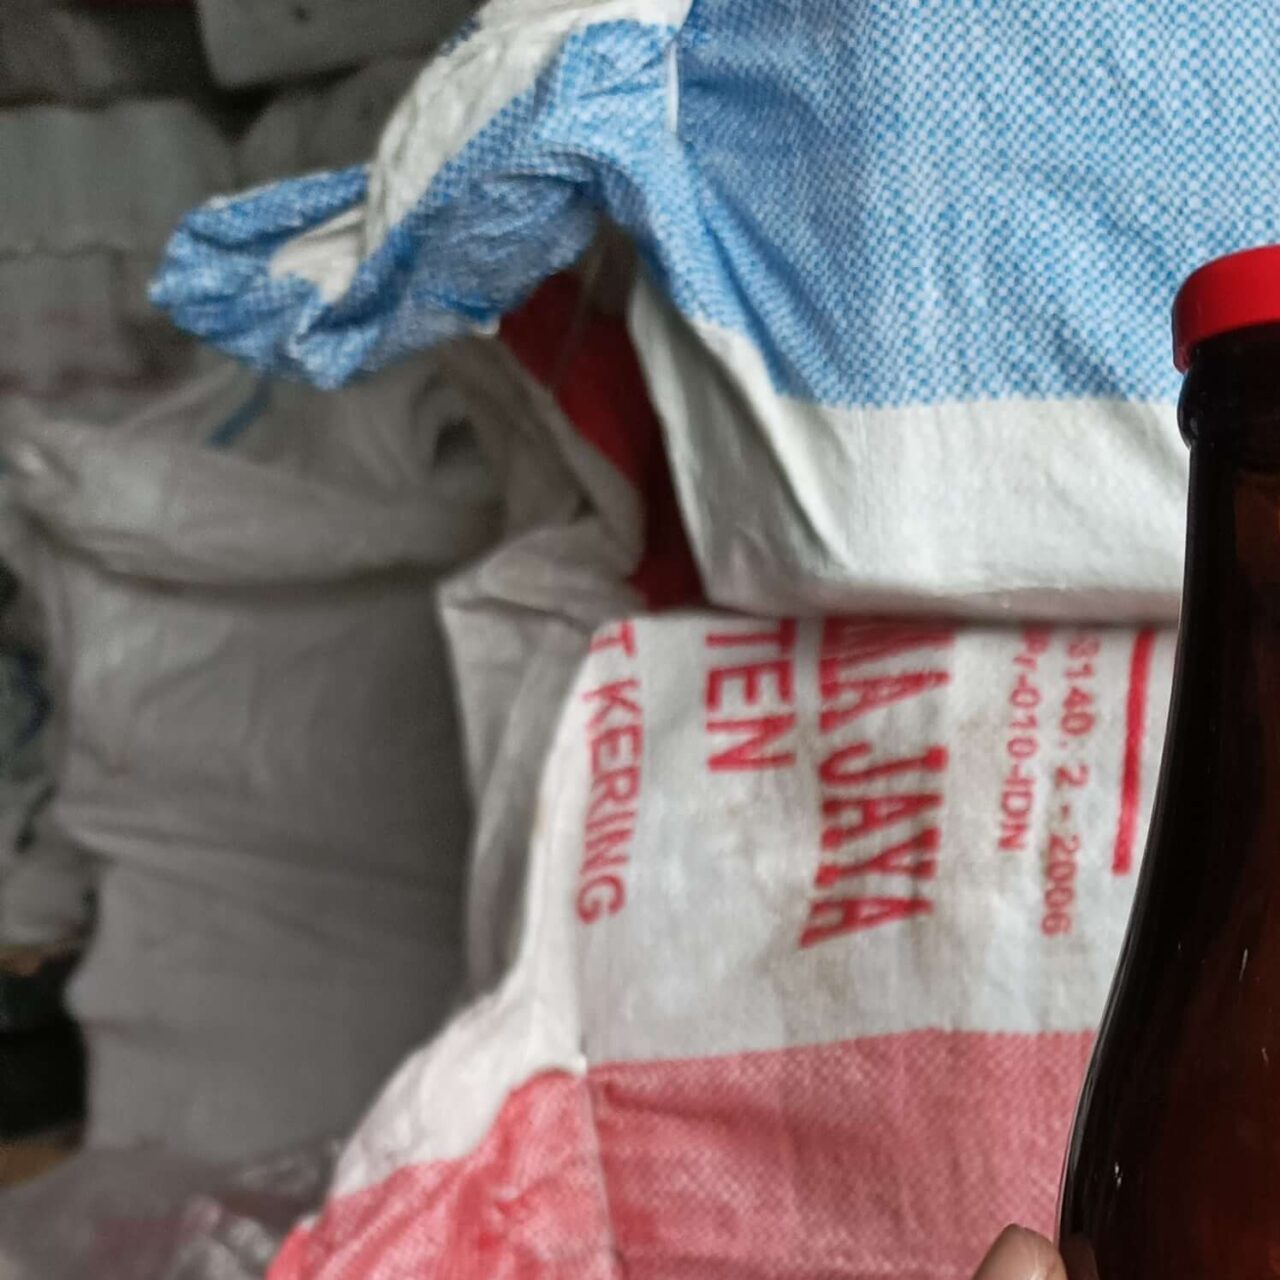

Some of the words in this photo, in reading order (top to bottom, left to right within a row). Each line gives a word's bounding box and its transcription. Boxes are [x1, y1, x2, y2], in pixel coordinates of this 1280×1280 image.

[705, 618, 797, 772] TEN
[576, 678, 643, 924] KERING
[800, 742, 948, 949] JAYA
[1040, 833, 1081, 937] 2006
